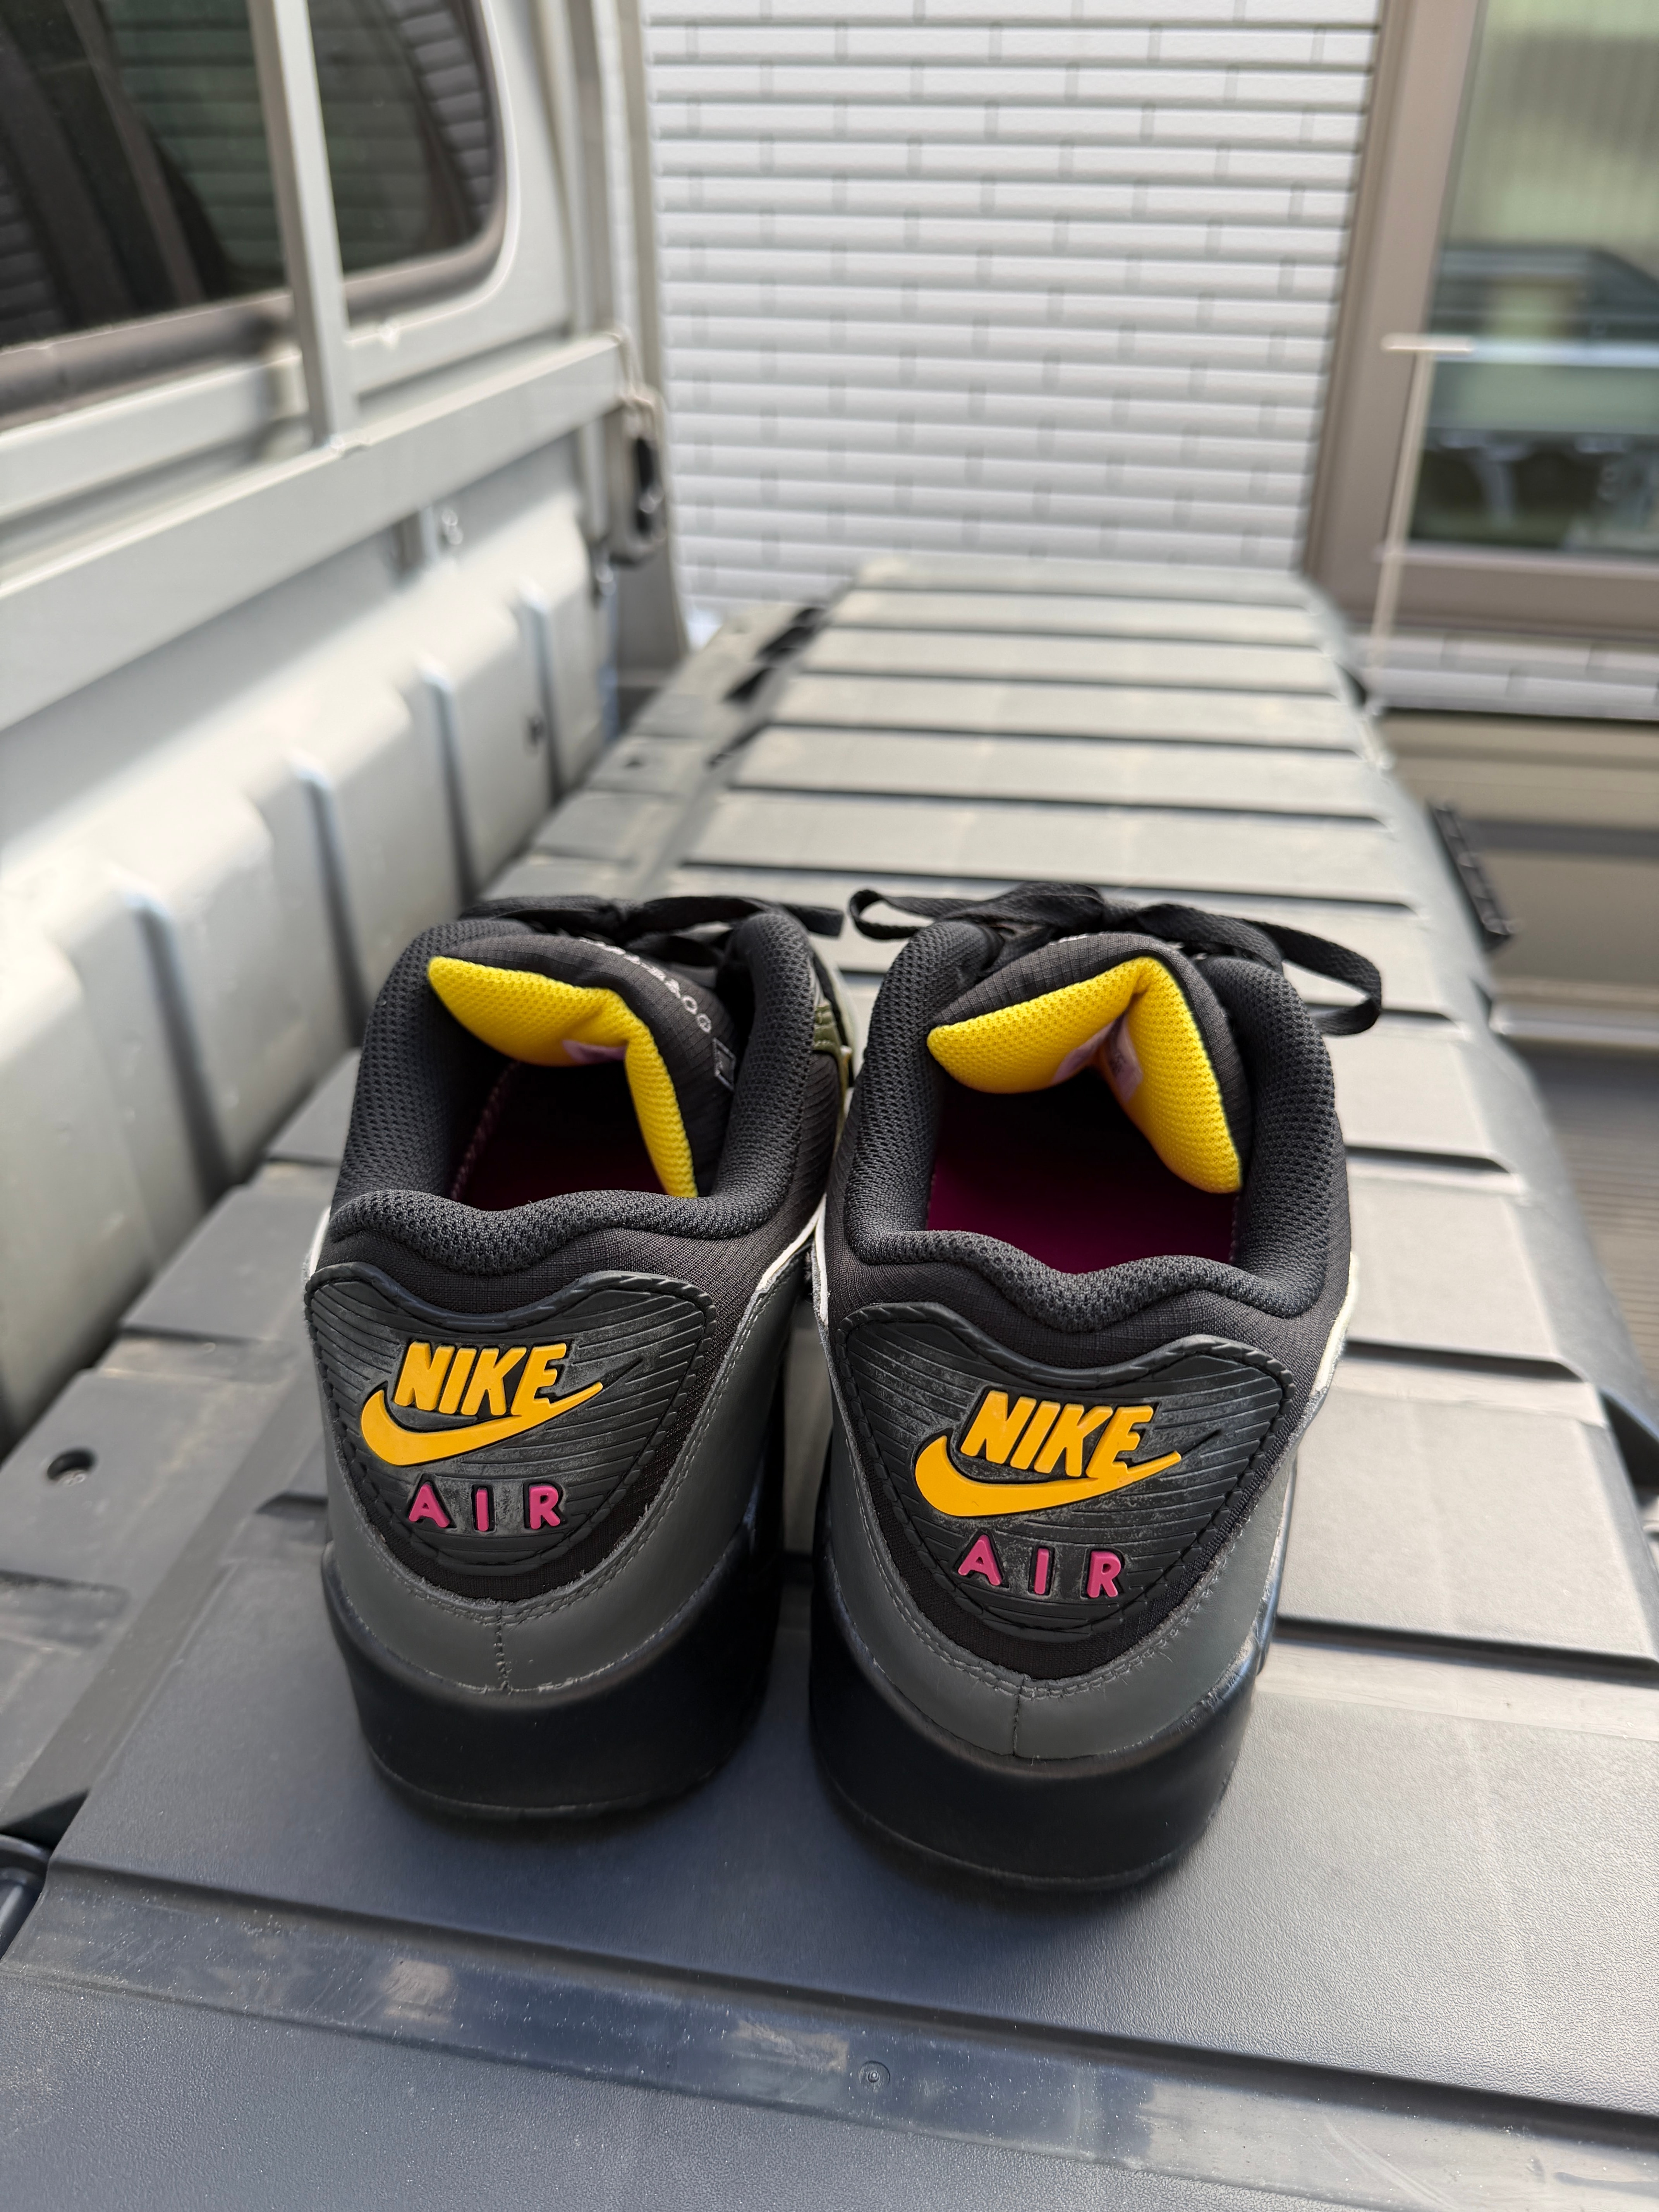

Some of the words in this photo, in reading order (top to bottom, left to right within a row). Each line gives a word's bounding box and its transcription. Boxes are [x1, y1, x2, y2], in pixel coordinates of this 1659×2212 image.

[394, 1341, 567, 1417] NIKE
[960, 1390, 1154, 1478] NIKE
[408, 1483, 561, 1532] AIR
[958, 1535, 1122, 1598] AIR
